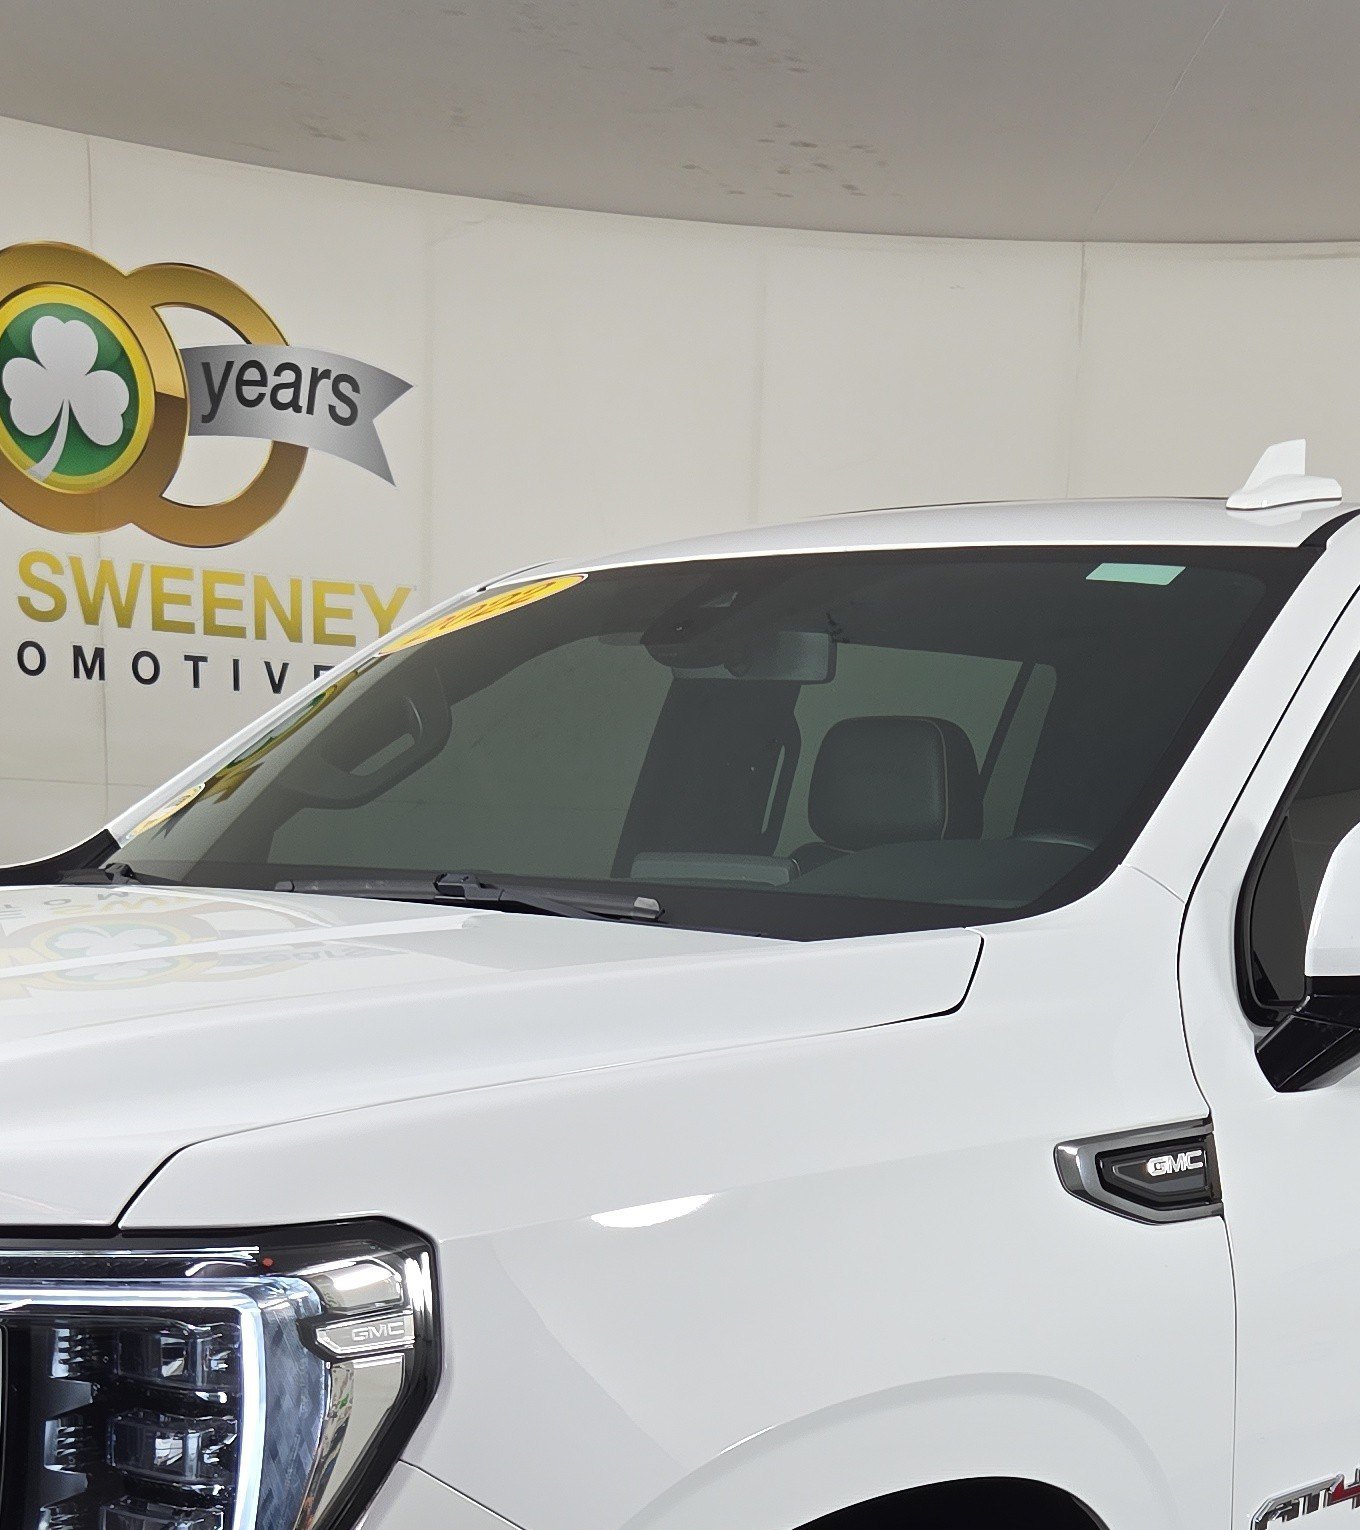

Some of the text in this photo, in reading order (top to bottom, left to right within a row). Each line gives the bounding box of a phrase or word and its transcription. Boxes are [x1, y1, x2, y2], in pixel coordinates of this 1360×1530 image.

[201, 355, 361, 427] years
[18, 550, 412, 648] SWEENEY
[1147, 1150, 1203, 1176] GMC
[352, 1321, 404, 1341] GMC
